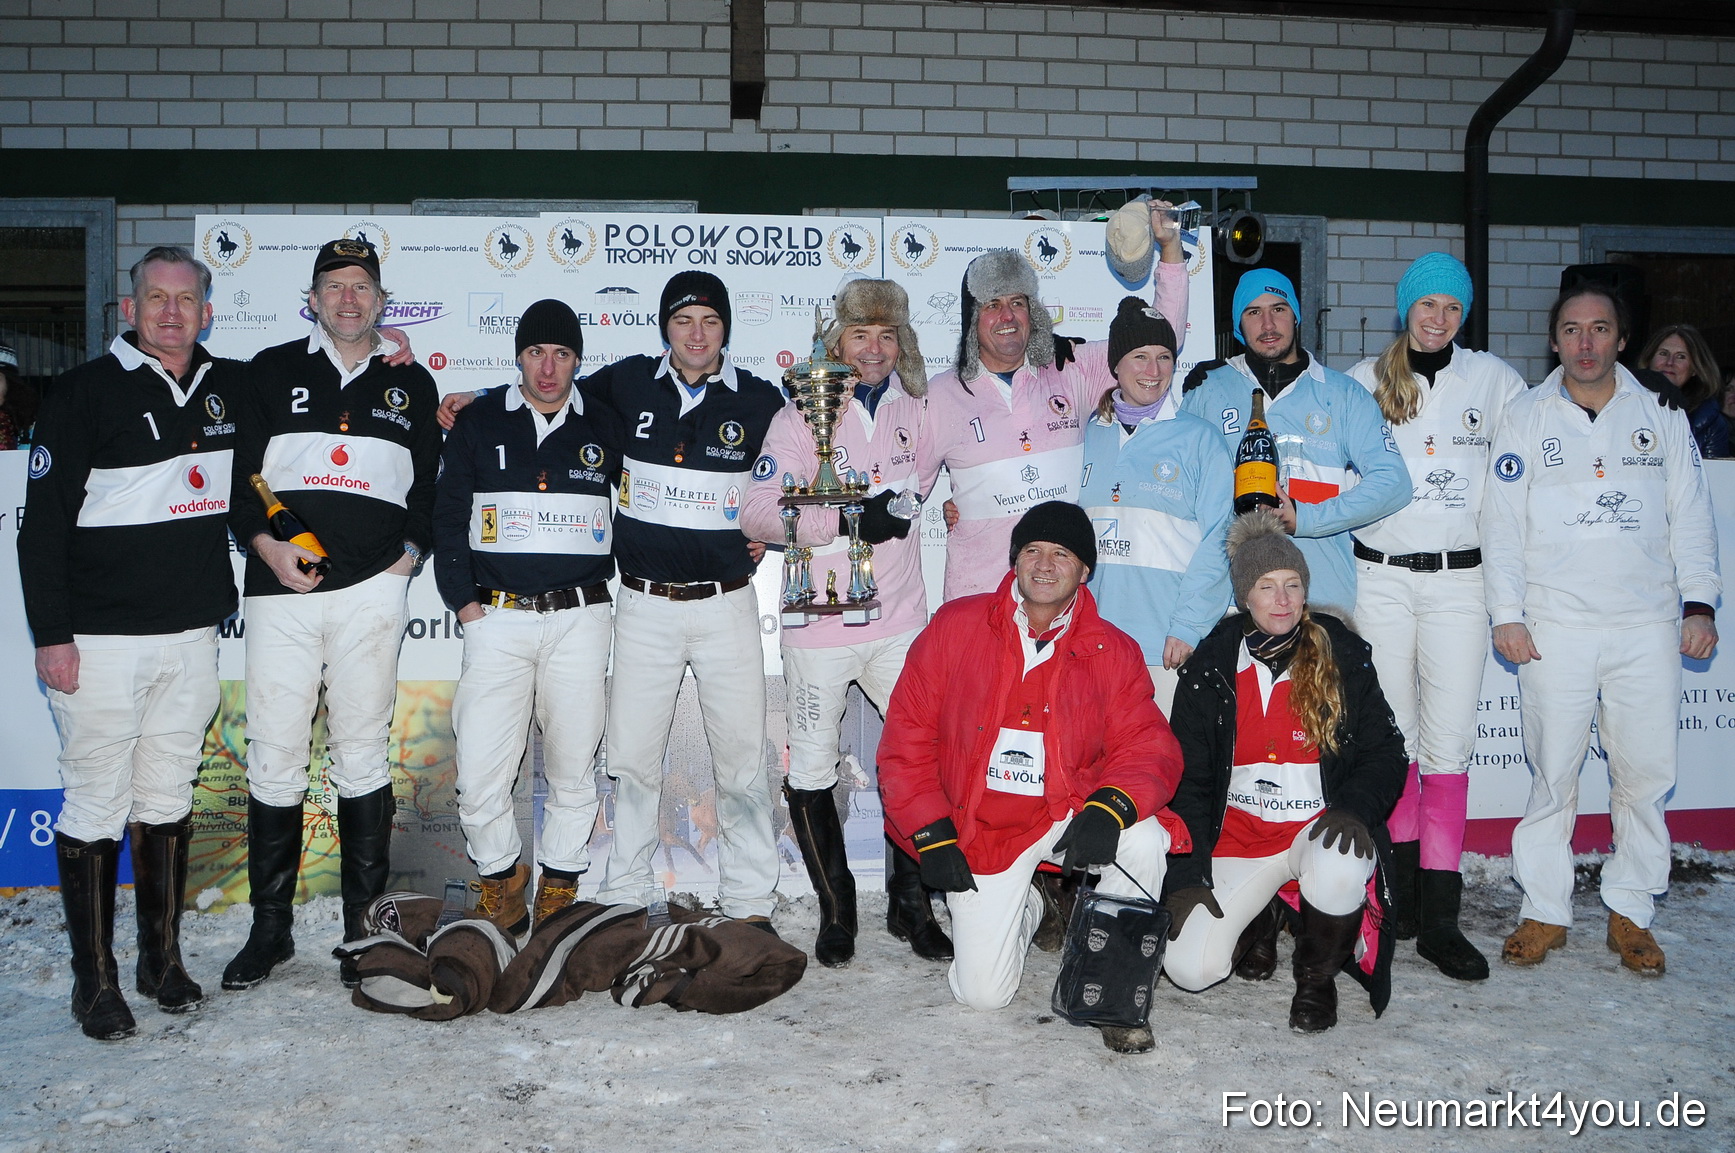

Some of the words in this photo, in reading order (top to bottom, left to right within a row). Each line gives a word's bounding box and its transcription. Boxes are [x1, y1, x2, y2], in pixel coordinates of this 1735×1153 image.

[258, 244, 325, 252] www.polo-world
[400, 244, 479, 253] www.polo-world.eu
[604, 248, 677, 264] TROPHY
[687, 249, 717, 265] ON
[780, 295, 832, 306] MERTE
[212, 314, 234, 322] euve
[236, 311, 278, 324] Clicquot
[383, 306, 443, 317] CHICHT
[579, 309, 658, 326] EL&VÖLK
[1078, 311, 1103, 319] Schmitt
[480, 316, 520, 327] MEYER
[479, 326, 518, 335] FINANC
[449, 357, 494, 367] network
[497, 357, 515, 367] lou
[581, 353, 607, 362] work
[925, 355, 952, 364] work
[291, 387, 310, 414] 2
[143, 411, 161, 441] 1
[635, 411, 654, 439] 2
[1222, 407, 1240, 436] 2
[969, 416, 986, 443] 1
[495, 444, 506, 470] 1
[1541, 437, 1564, 468] 2
[833, 446, 852, 476] 2
[1081, 463, 1093, 487] 1
[302, 474, 371, 491] vodafone
[665, 486, 717, 501] MERTEL
[993, 494, 1026, 507] Veuve
[1027, 484, 1068, 501] Clicquot
[169, 498, 227, 515] vodafone
[538, 512, 588, 524] MERTEL
[1098, 539, 1131, 550] MEYER
[1098, 548, 1130, 557] FINANCE
[1680, 689, 1708, 703] ATI
[1715, 689, 1735, 703] Ve
[1477, 700, 1492, 711] er
[1715, 714, 1735, 729] Co
[1477, 723, 1523, 738] ßrau
[202, 761, 232, 771] ARIO
[392, 776, 431, 786] lorida
[986, 767, 1045, 784] EL&VÖLK
[304, 794, 332, 804] RES
[29, 810, 55, 847] 8
